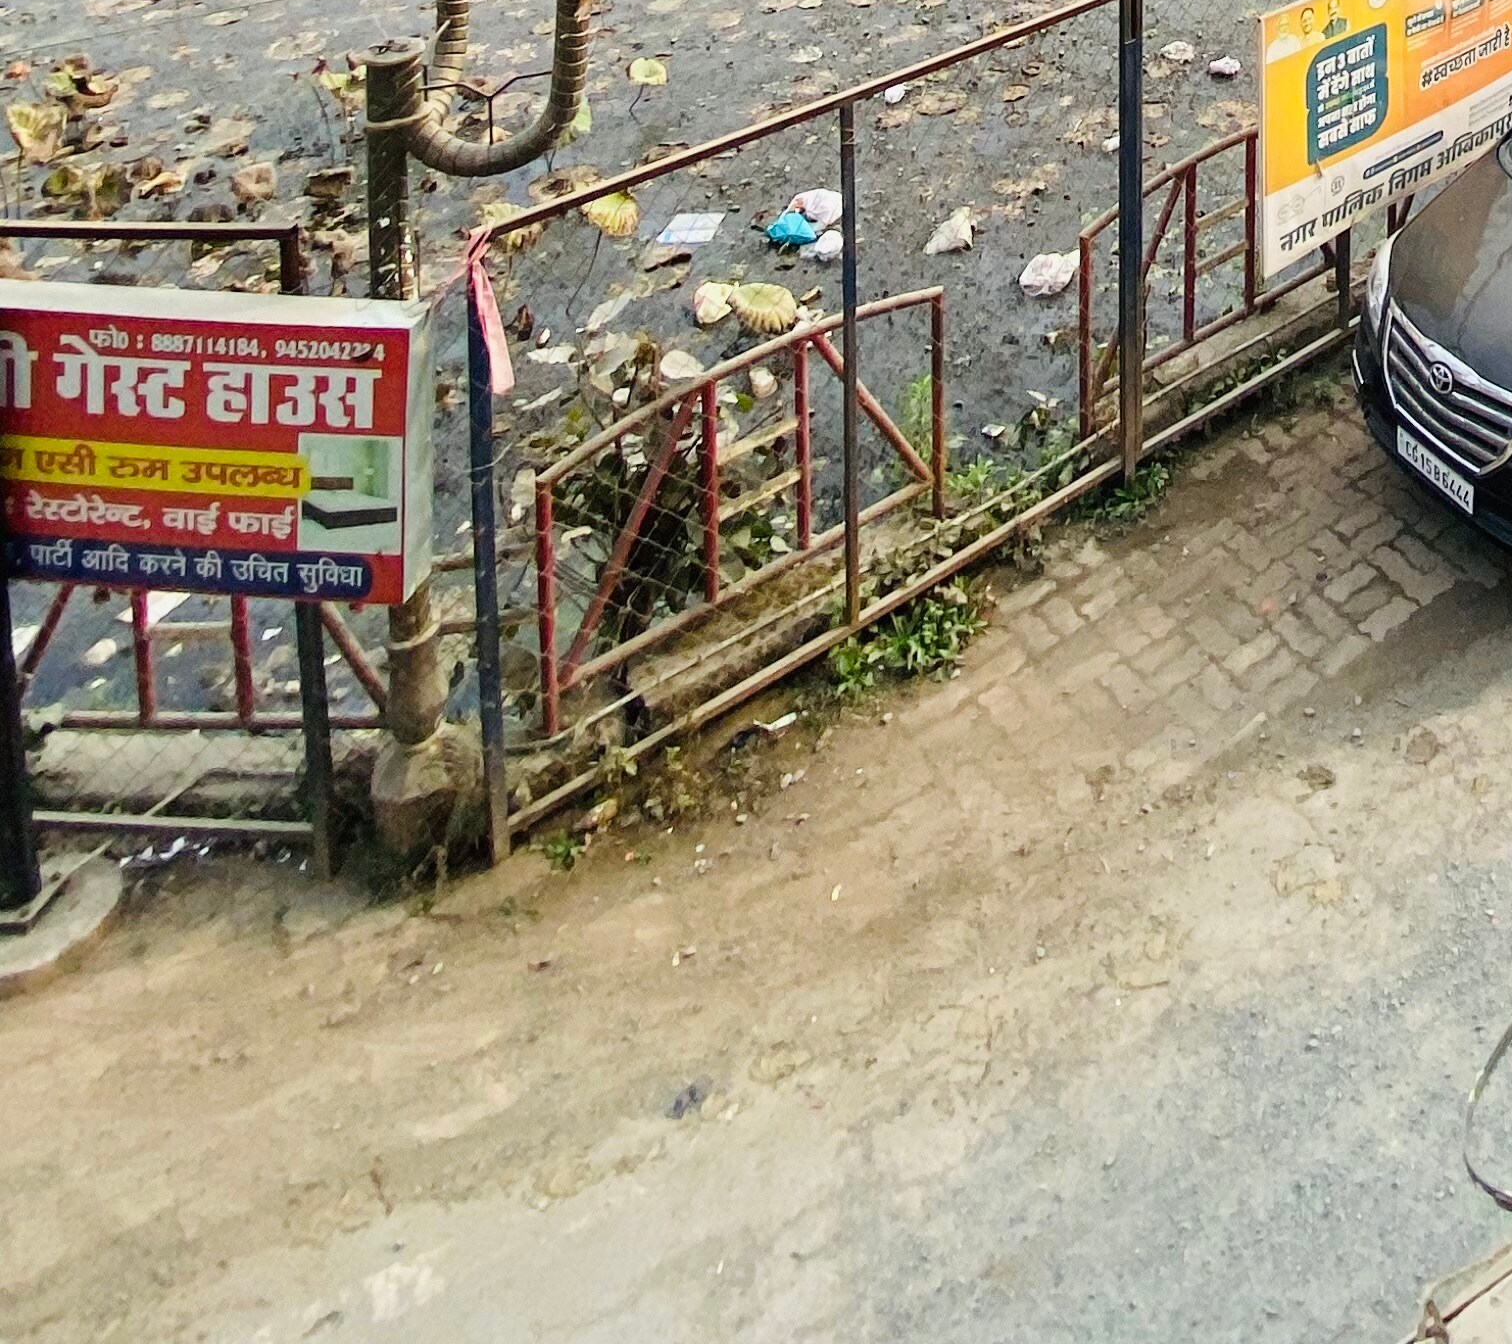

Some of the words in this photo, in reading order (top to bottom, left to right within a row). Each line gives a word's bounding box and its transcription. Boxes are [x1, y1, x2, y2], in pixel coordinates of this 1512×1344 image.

[1421, 47, 1477, 88] #स्वच्छता
[1478, 29, 1502, 57] जारी
[1504, 23, 1510, 47] है
[1279, 218, 1318, 251] नगर
[1321, 182, 1385, 227] पालिक
[1388, 157, 1433, 196] निगम
[52, 334, 192, 419] गेस्ट
[203, 361, 383, 429] हाउस
[34, 443, 97, 476] एसी
[180, 461, 304, 489] उपलब्ध
[161, 501, 221, 536] वाई
[227, 505, 296, 540] फाई
[29, 538, 74, 569] पार्टी
[81, 543, 131, 573] आदि
[137, 548, 187, 577] करने
[194, 550, 224, 579] की
[230, 552, 290, 584] उचित
[296, 557, 364, 594] सुविधा
